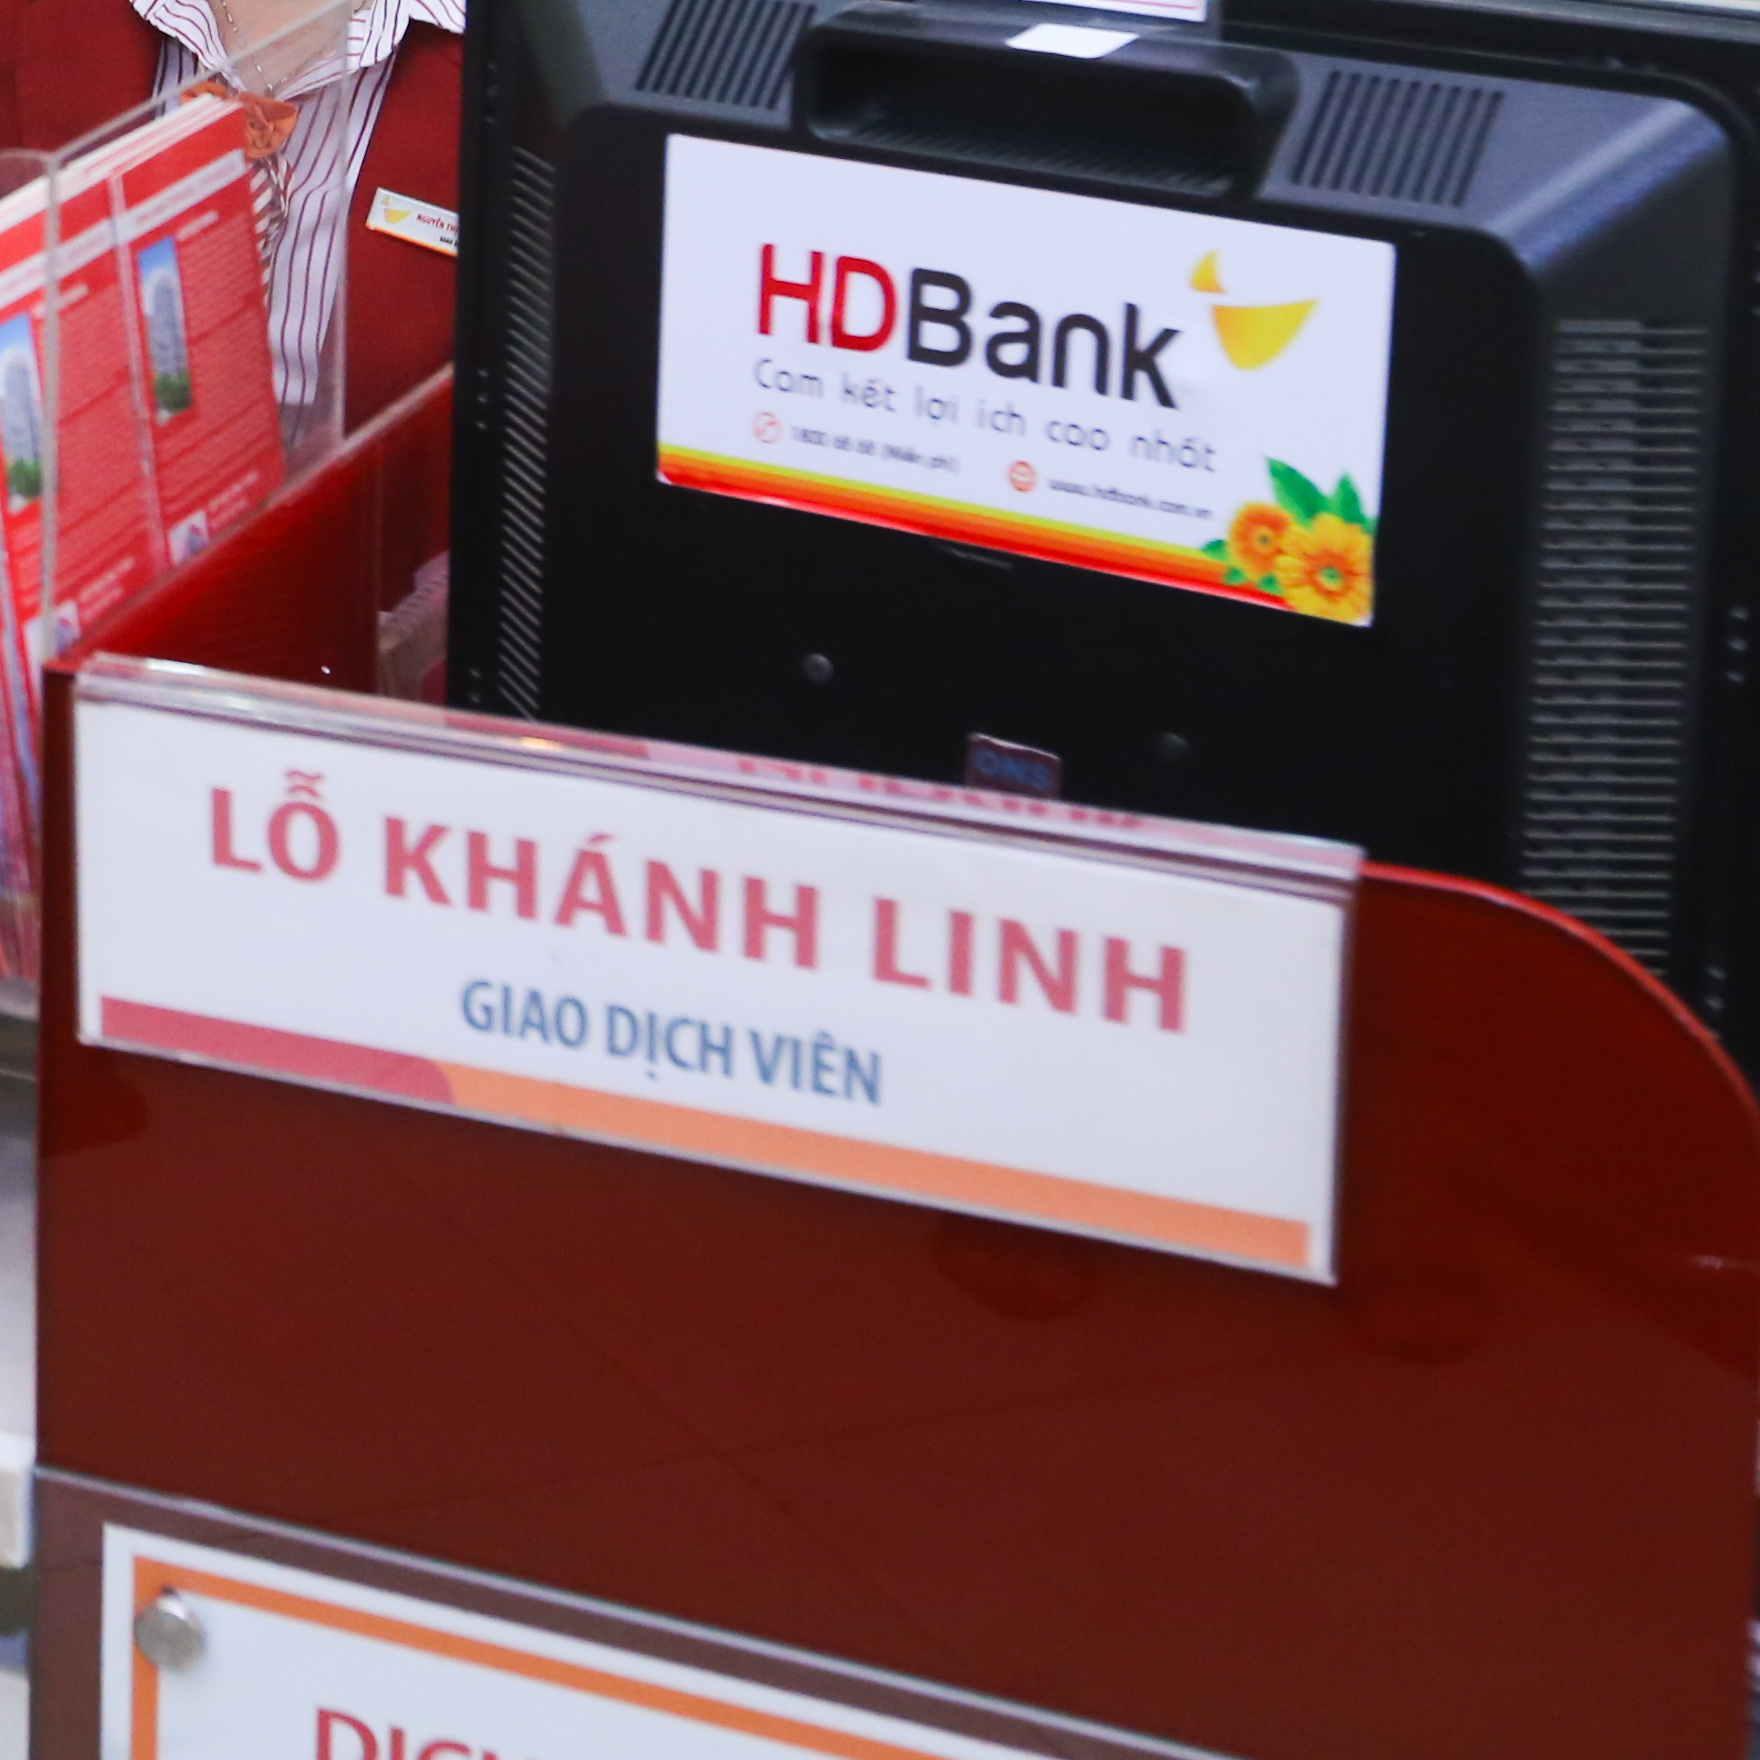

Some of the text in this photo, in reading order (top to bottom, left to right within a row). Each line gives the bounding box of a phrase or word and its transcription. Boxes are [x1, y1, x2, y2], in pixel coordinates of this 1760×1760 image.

[755, 241, 1182, 410] HDBank
[755, 358, 824, 397] Cam
[842, 372, 897, 412] kết
[914, 387, 960, 428] lợi
[1046, 415, 1110, 451] cao
[1130, 427, 1217, 472] nhất
[205, 769, 1188, 1035] LỖ KHÁNH LINH
[461, 977, 884, 1109] GIAO DỊCH VIÊN
